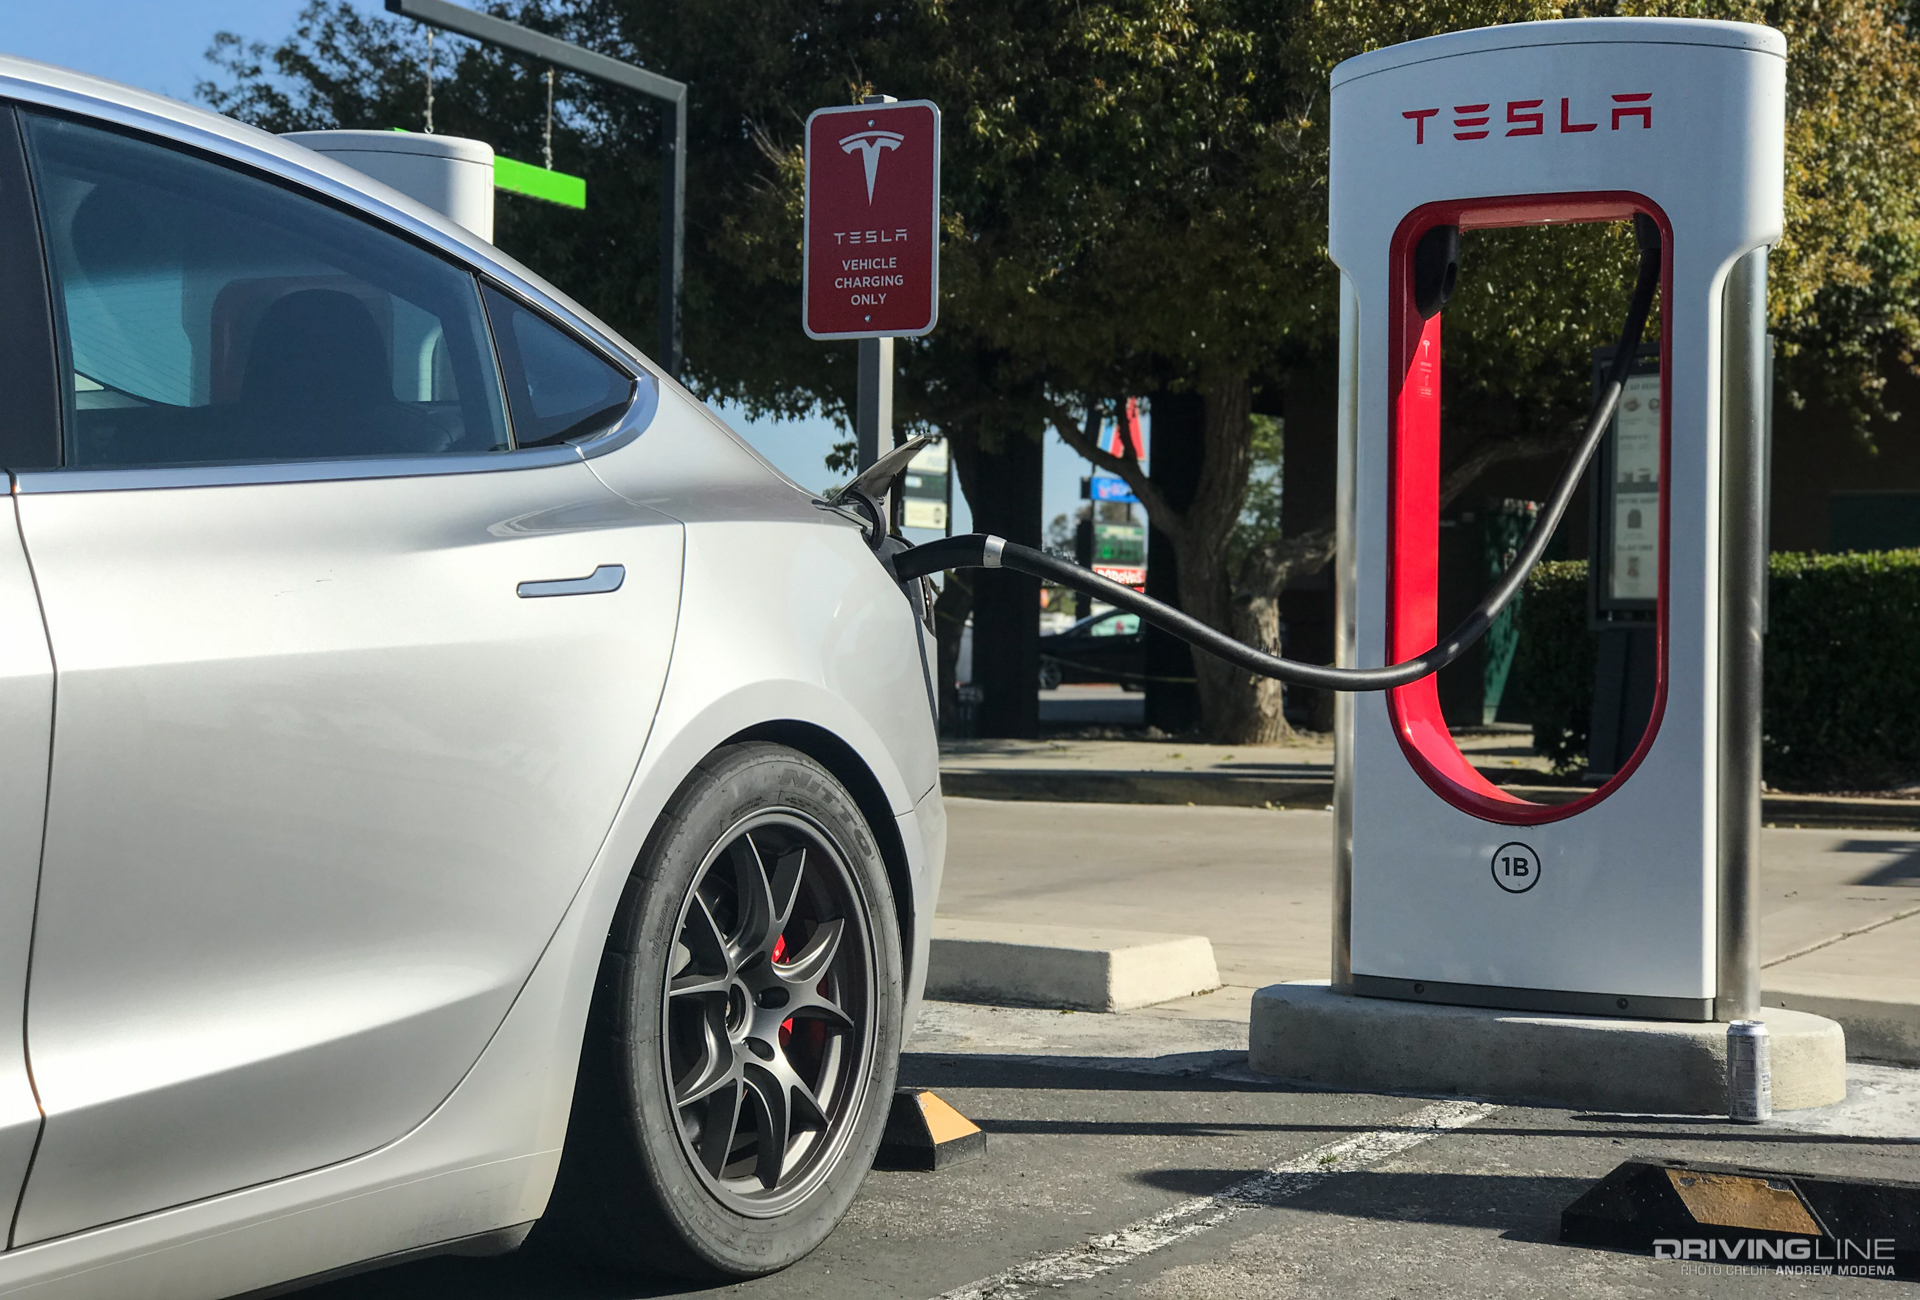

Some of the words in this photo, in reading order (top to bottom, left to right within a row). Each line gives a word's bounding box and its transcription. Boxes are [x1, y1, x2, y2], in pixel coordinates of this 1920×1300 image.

[1401, 92, 1653, 145] TESLA
[834, 229, 907, 244] TESLA
[842, 257, 896, 270] VEHICLE
[834, 274, 904, 289] CHARGING
[850, 293, 887, 306] ONLY
[779, 767, 873, 857] NITTO
[1501, 857, 1530, 877] 1B
